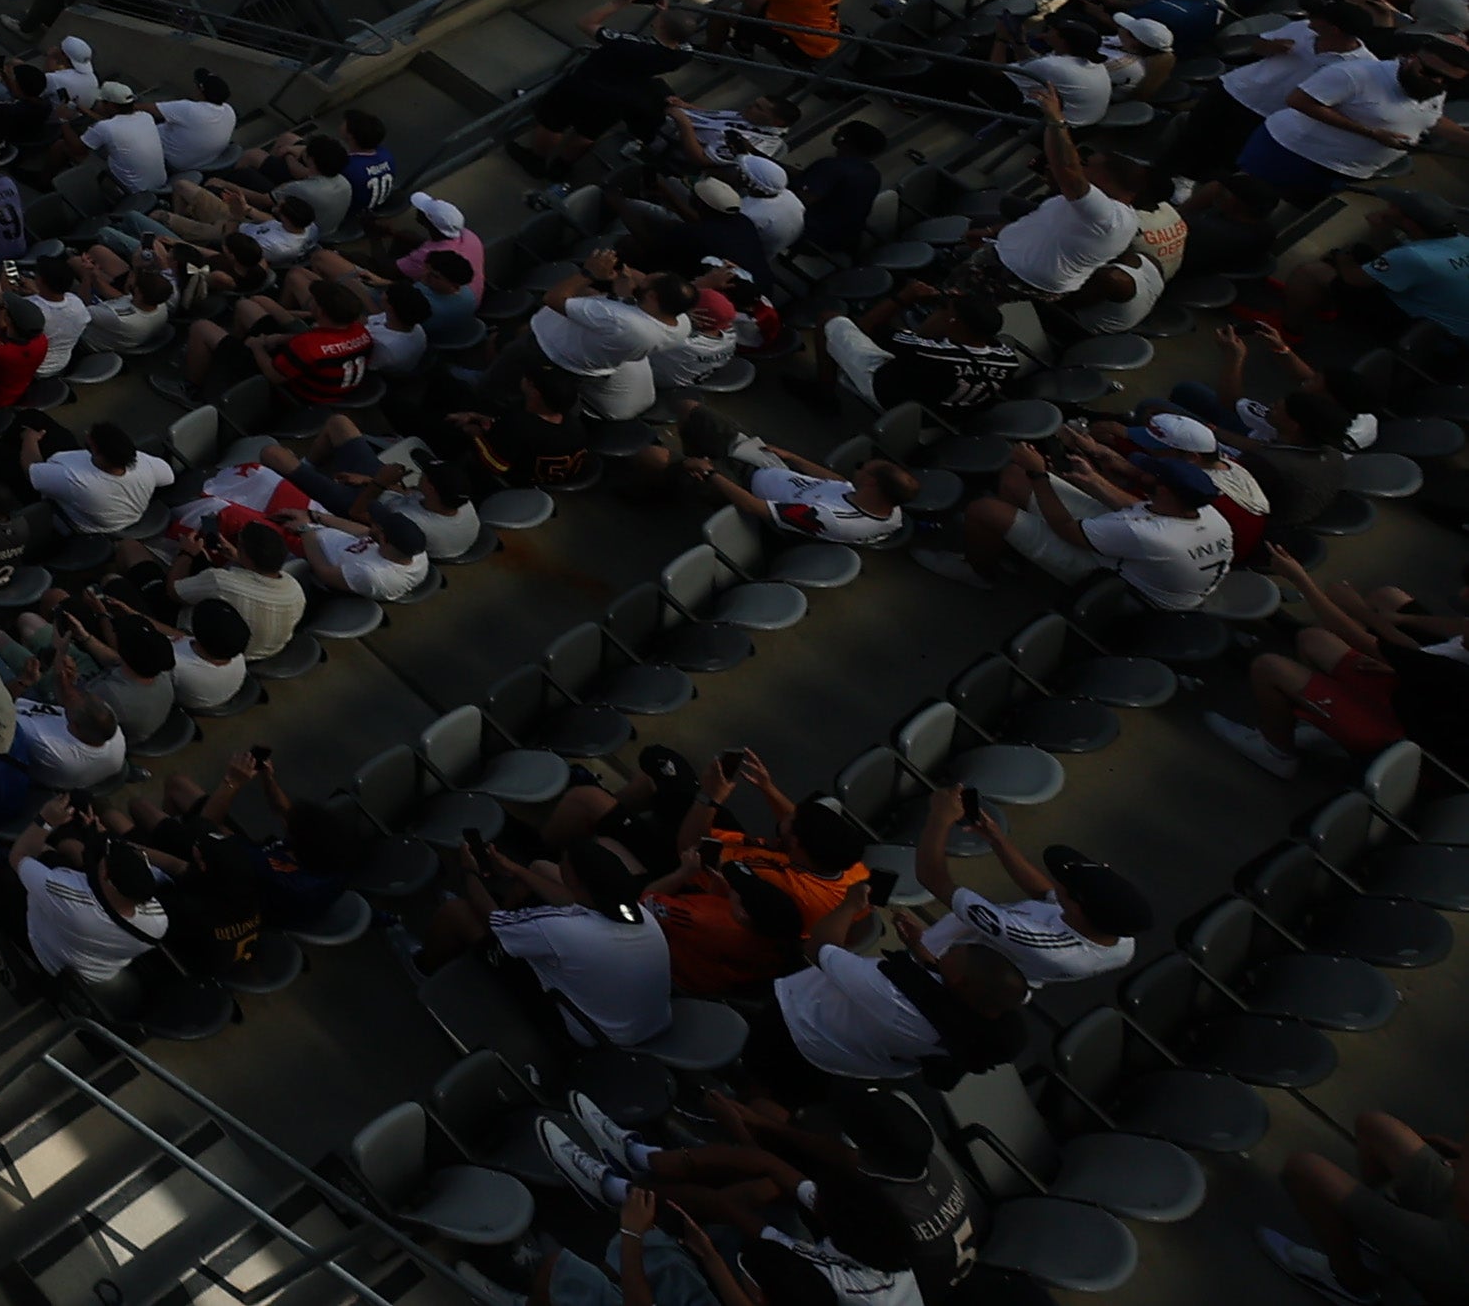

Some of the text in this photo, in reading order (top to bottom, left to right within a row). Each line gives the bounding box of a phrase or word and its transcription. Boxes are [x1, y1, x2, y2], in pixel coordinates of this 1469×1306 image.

[367, 172, 394, 210] 10
[341, 356, 366, 388] 11
[1200, 560, 1227, 593] 7
[951, 1215, 978, 1279] 5
